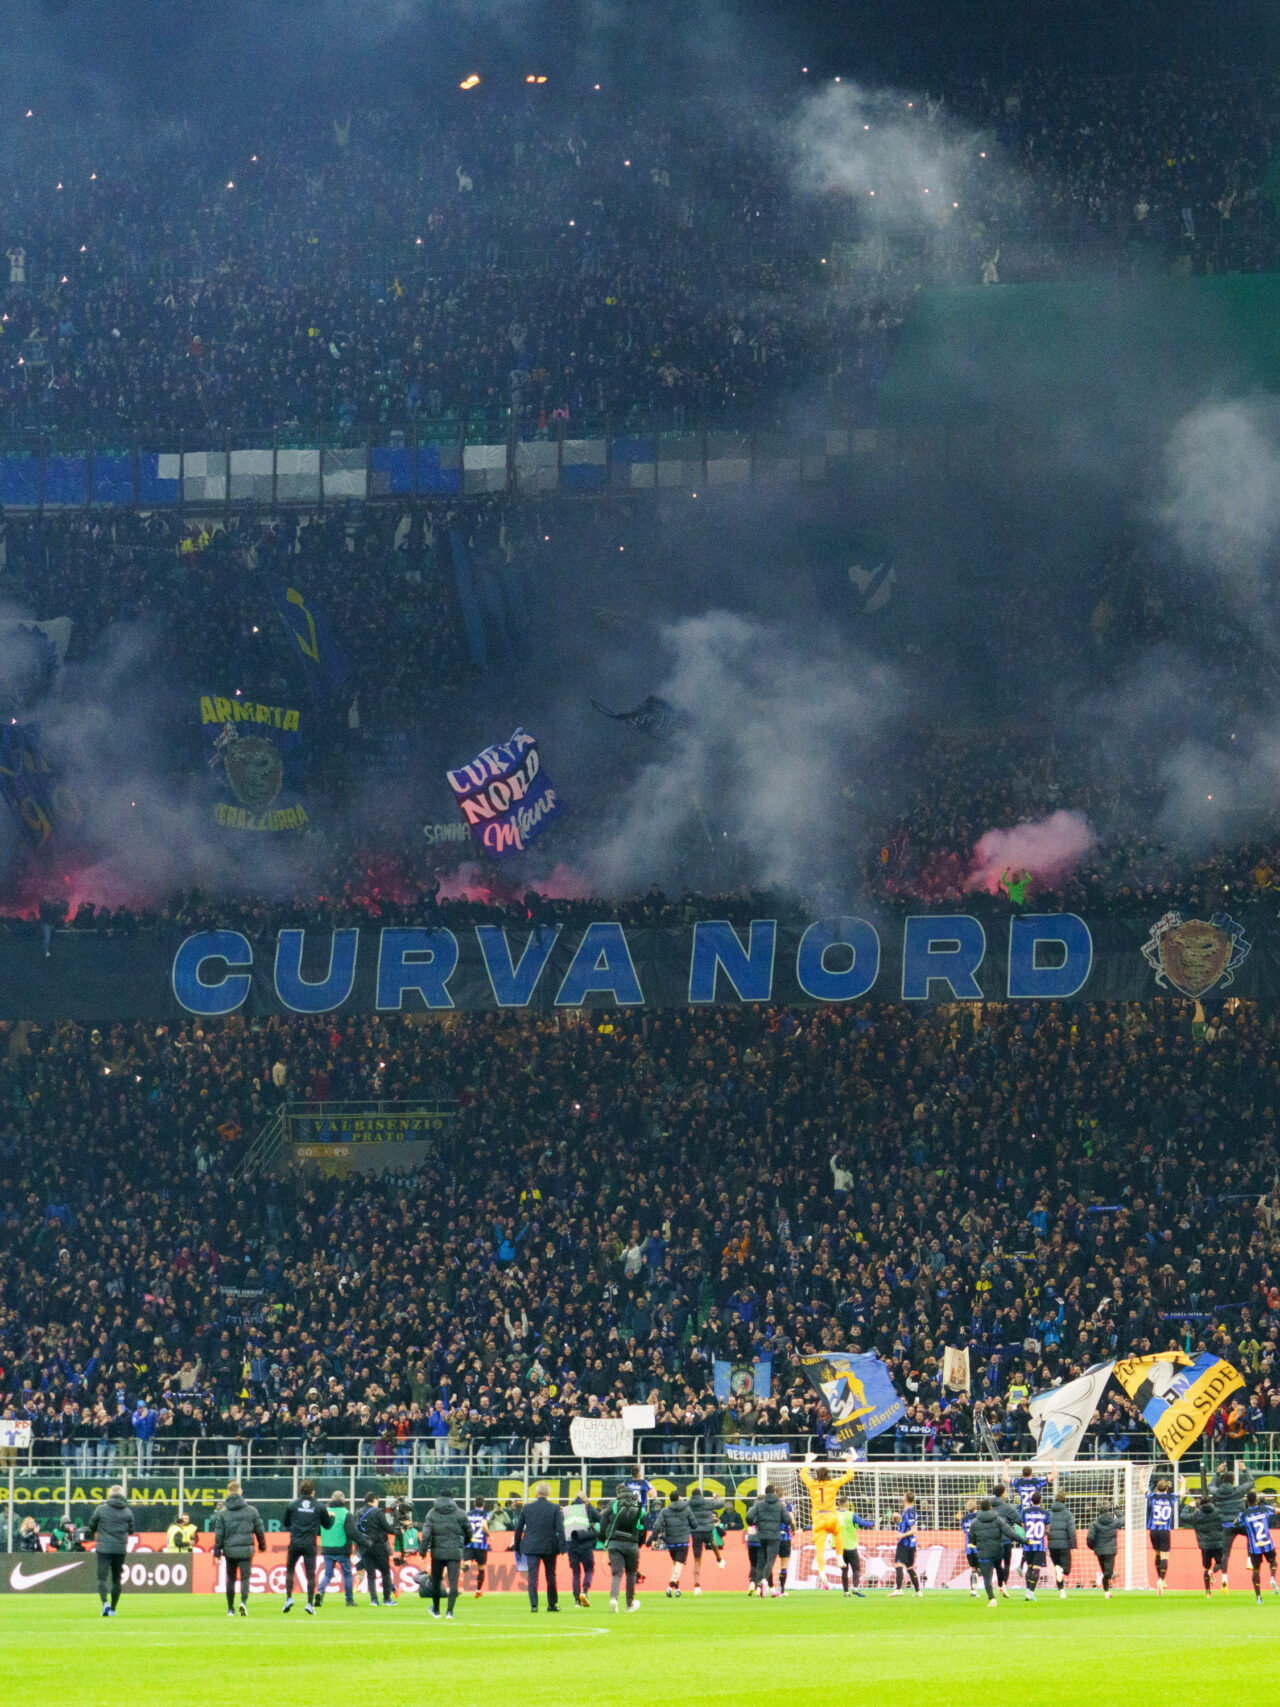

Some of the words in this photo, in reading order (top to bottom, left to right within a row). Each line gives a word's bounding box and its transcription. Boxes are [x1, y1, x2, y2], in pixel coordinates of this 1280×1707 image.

[461, 748, 540, 825] NORD
[171, 921, 646, 1016] CURVA
[687, 911, 1094, 1004] NORD
[1161, 1413, 1195, 1452] RHO
[1193, 1365, 1239, 1415] SIDE
[726, 1447, 788, 1462] BESCALDINA
[1153, 1503, 1172, 1521] 30
[1025, 1520, 1046, 1539] 20
[1253, 1521, 1266, 1540] 2
[121, 1563, 188, 1587] 90:00
